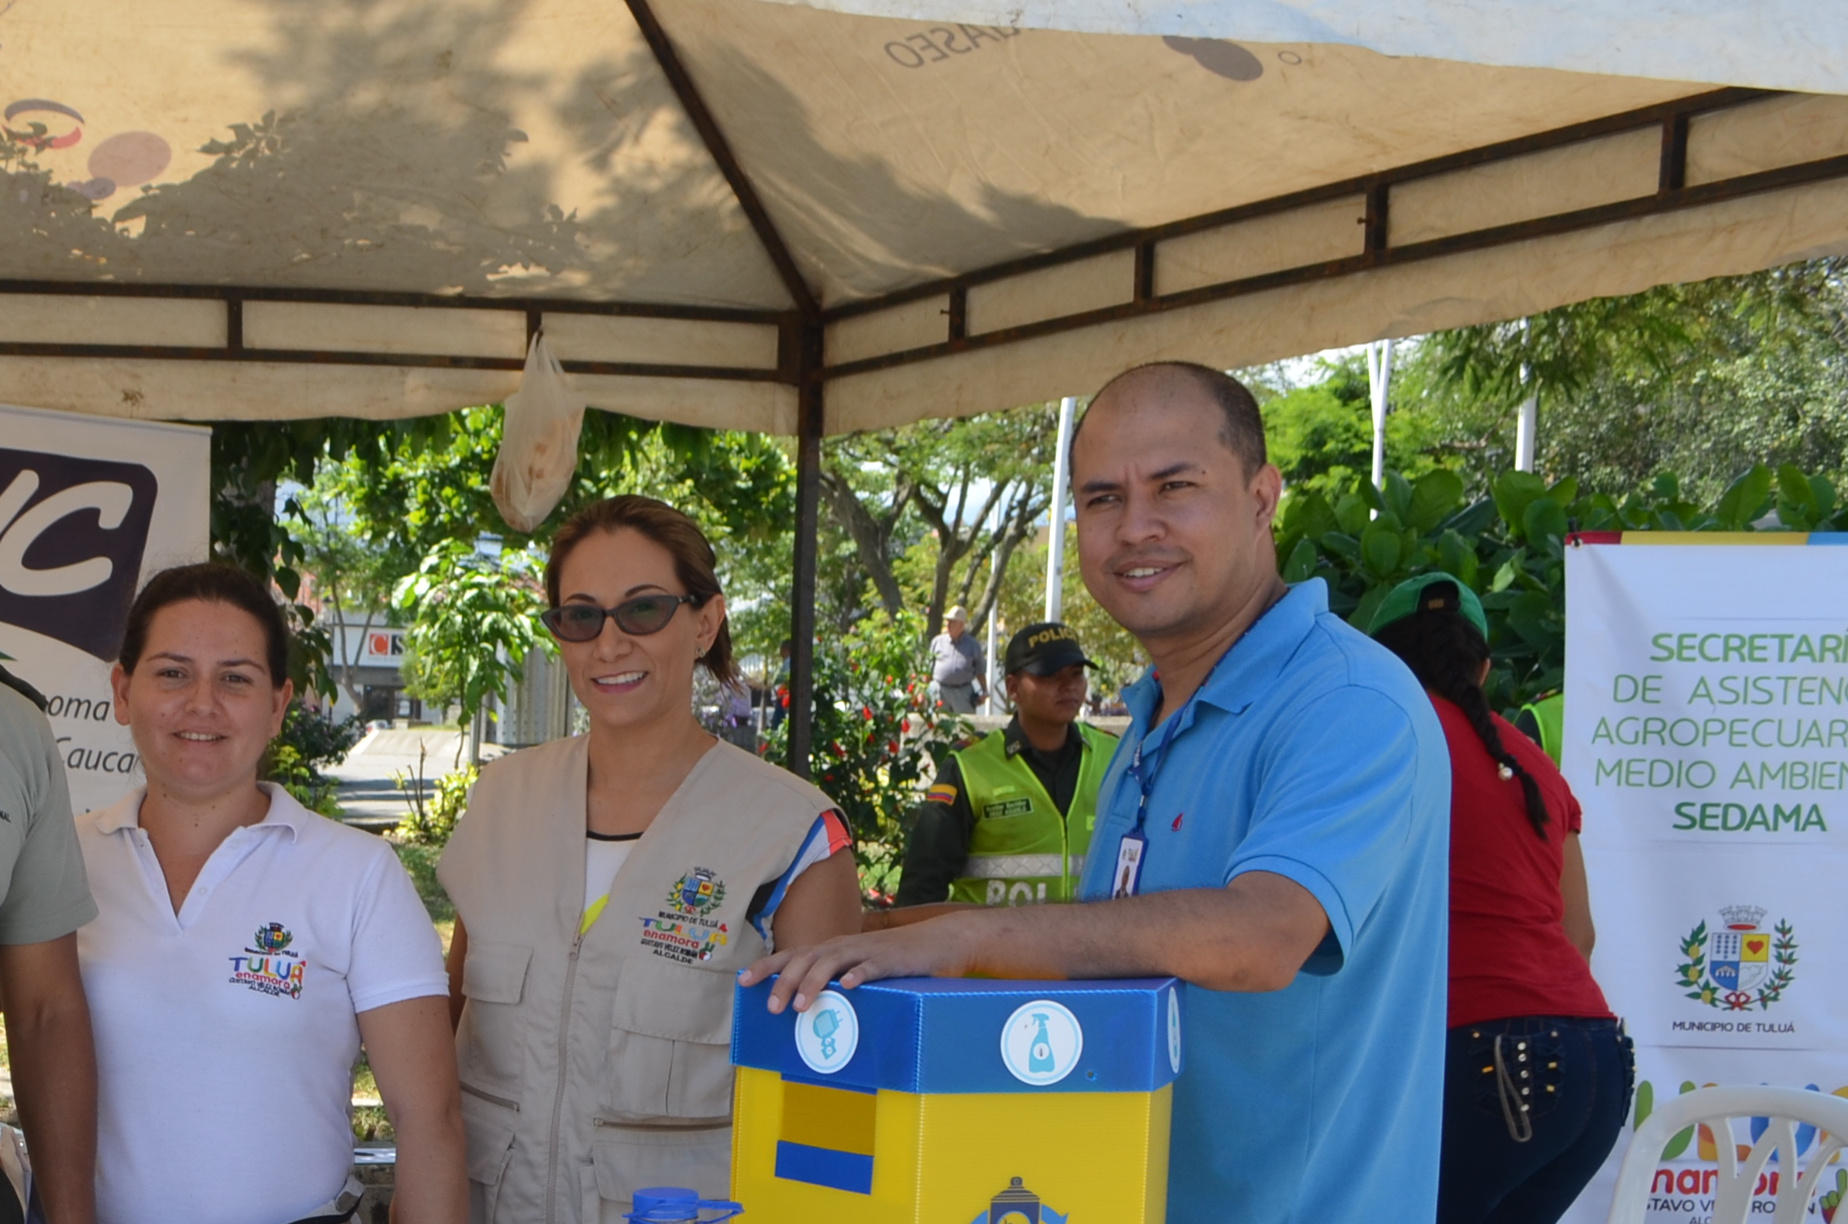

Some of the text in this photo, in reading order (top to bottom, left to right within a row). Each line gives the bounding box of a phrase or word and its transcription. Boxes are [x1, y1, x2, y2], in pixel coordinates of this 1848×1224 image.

[1613, 674, 1663, 704] DE
[1591, 716, 1848, 748] AGROPECUAR
[1595, 758, 1717, 788] MEDIO
[1672, 801, 1828, 832] SEDAMA
[642, 928, 701, 950] enamora
[652, 948, 694, 965] ALCALDE
[235, 971, 291, 990] enamora
[1672, 1021, 1795, 1033] MUNICIPIO DE TULUÁ
